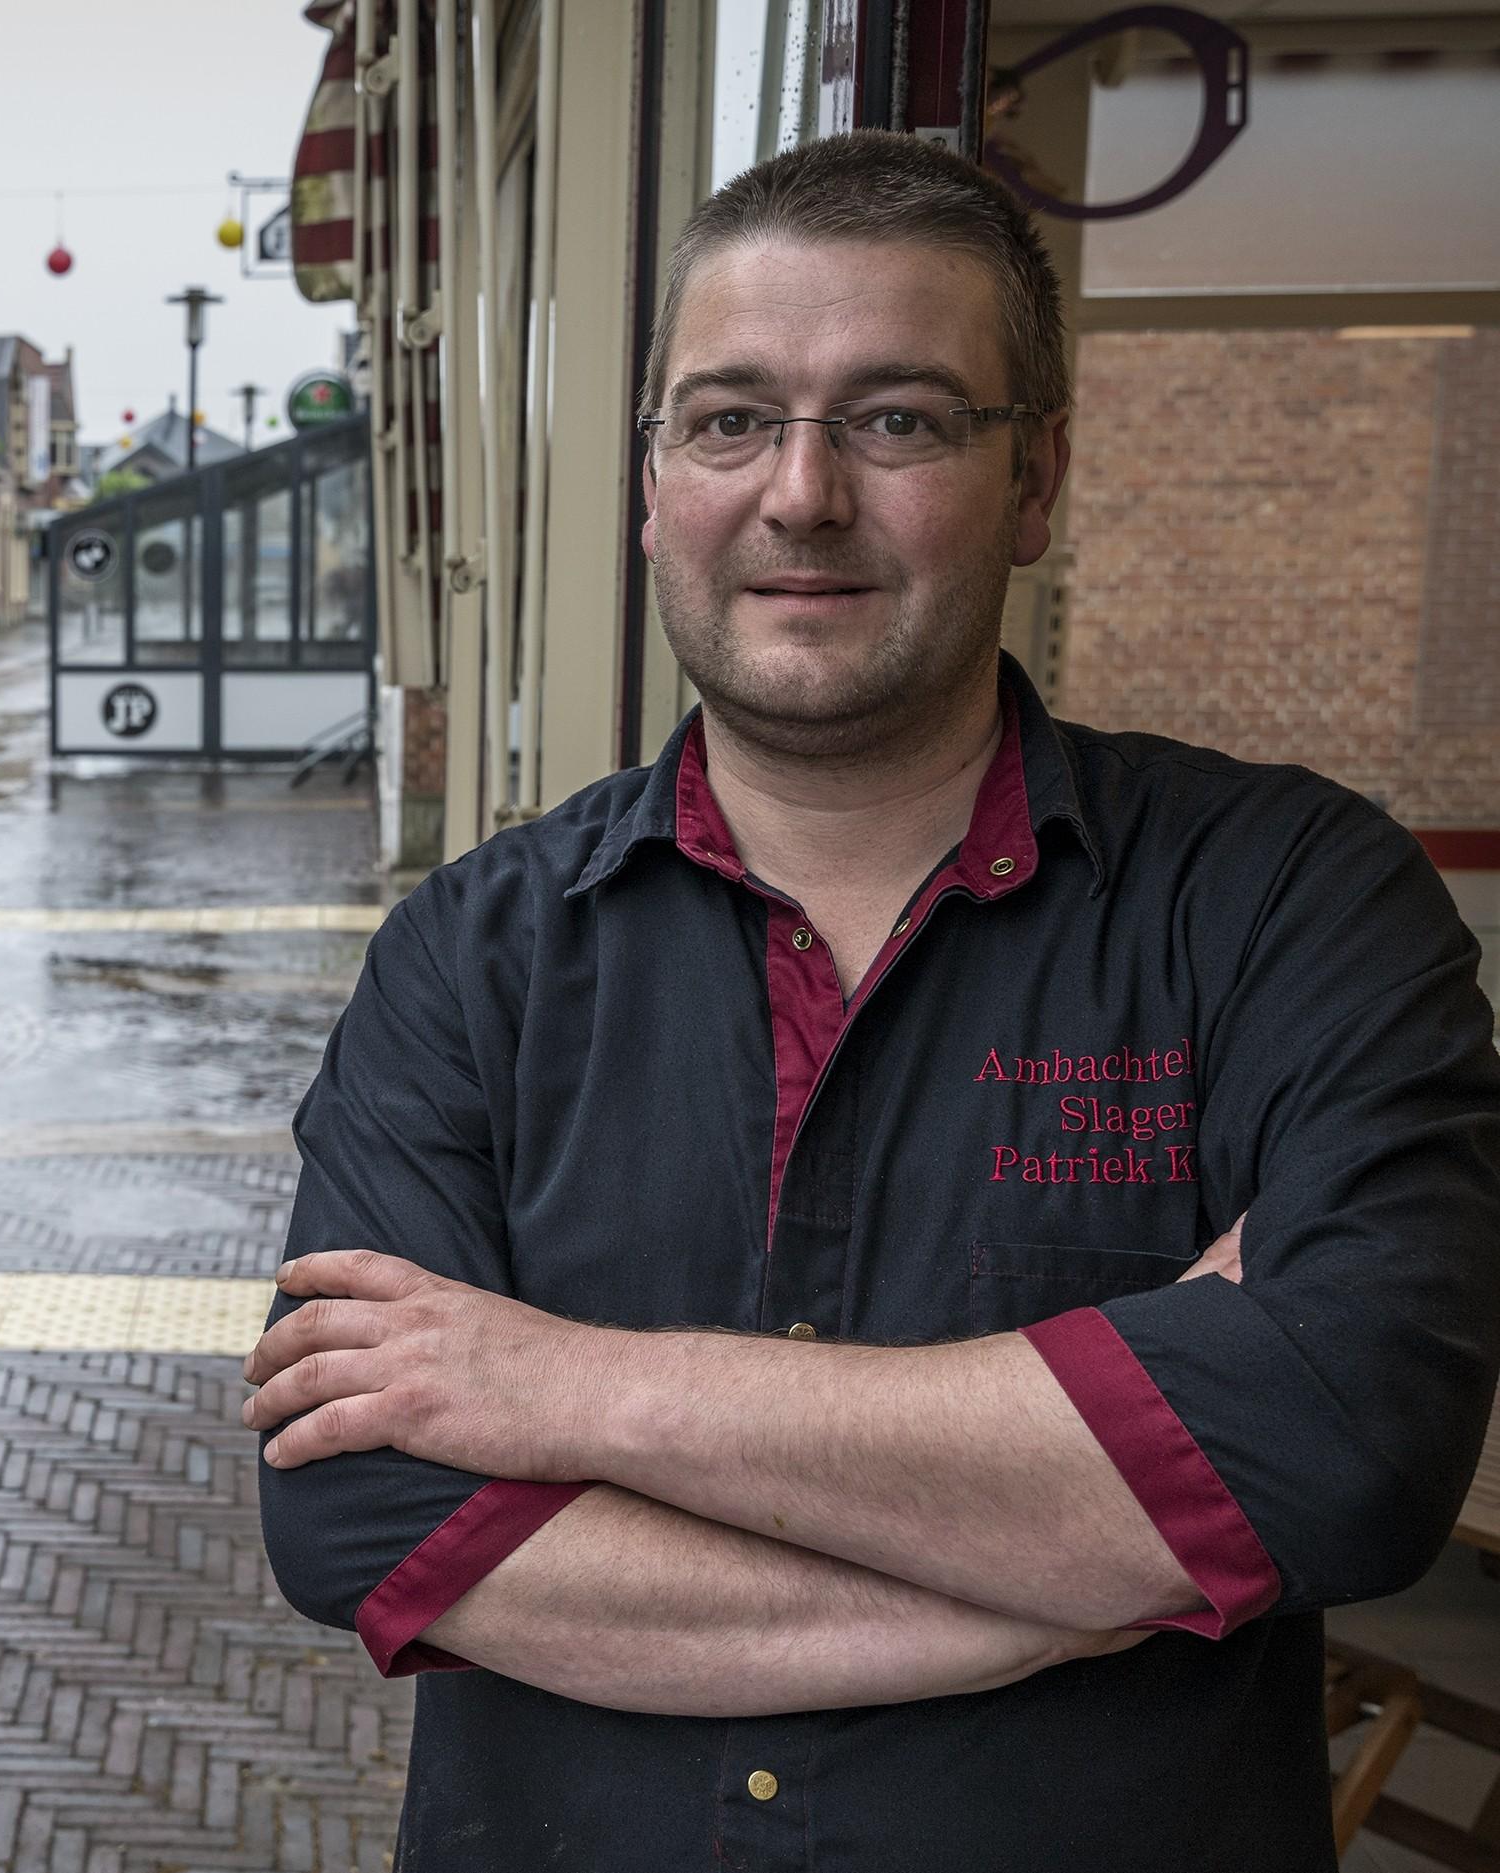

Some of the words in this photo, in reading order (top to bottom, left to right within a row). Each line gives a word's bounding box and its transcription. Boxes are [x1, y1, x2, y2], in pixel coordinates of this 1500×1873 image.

[973, 1038, 1197, 1084] Ambachtel
[1059, 1096, 1197, 1141] Slager
[989, 1146, 1157, 1184] Patriek
